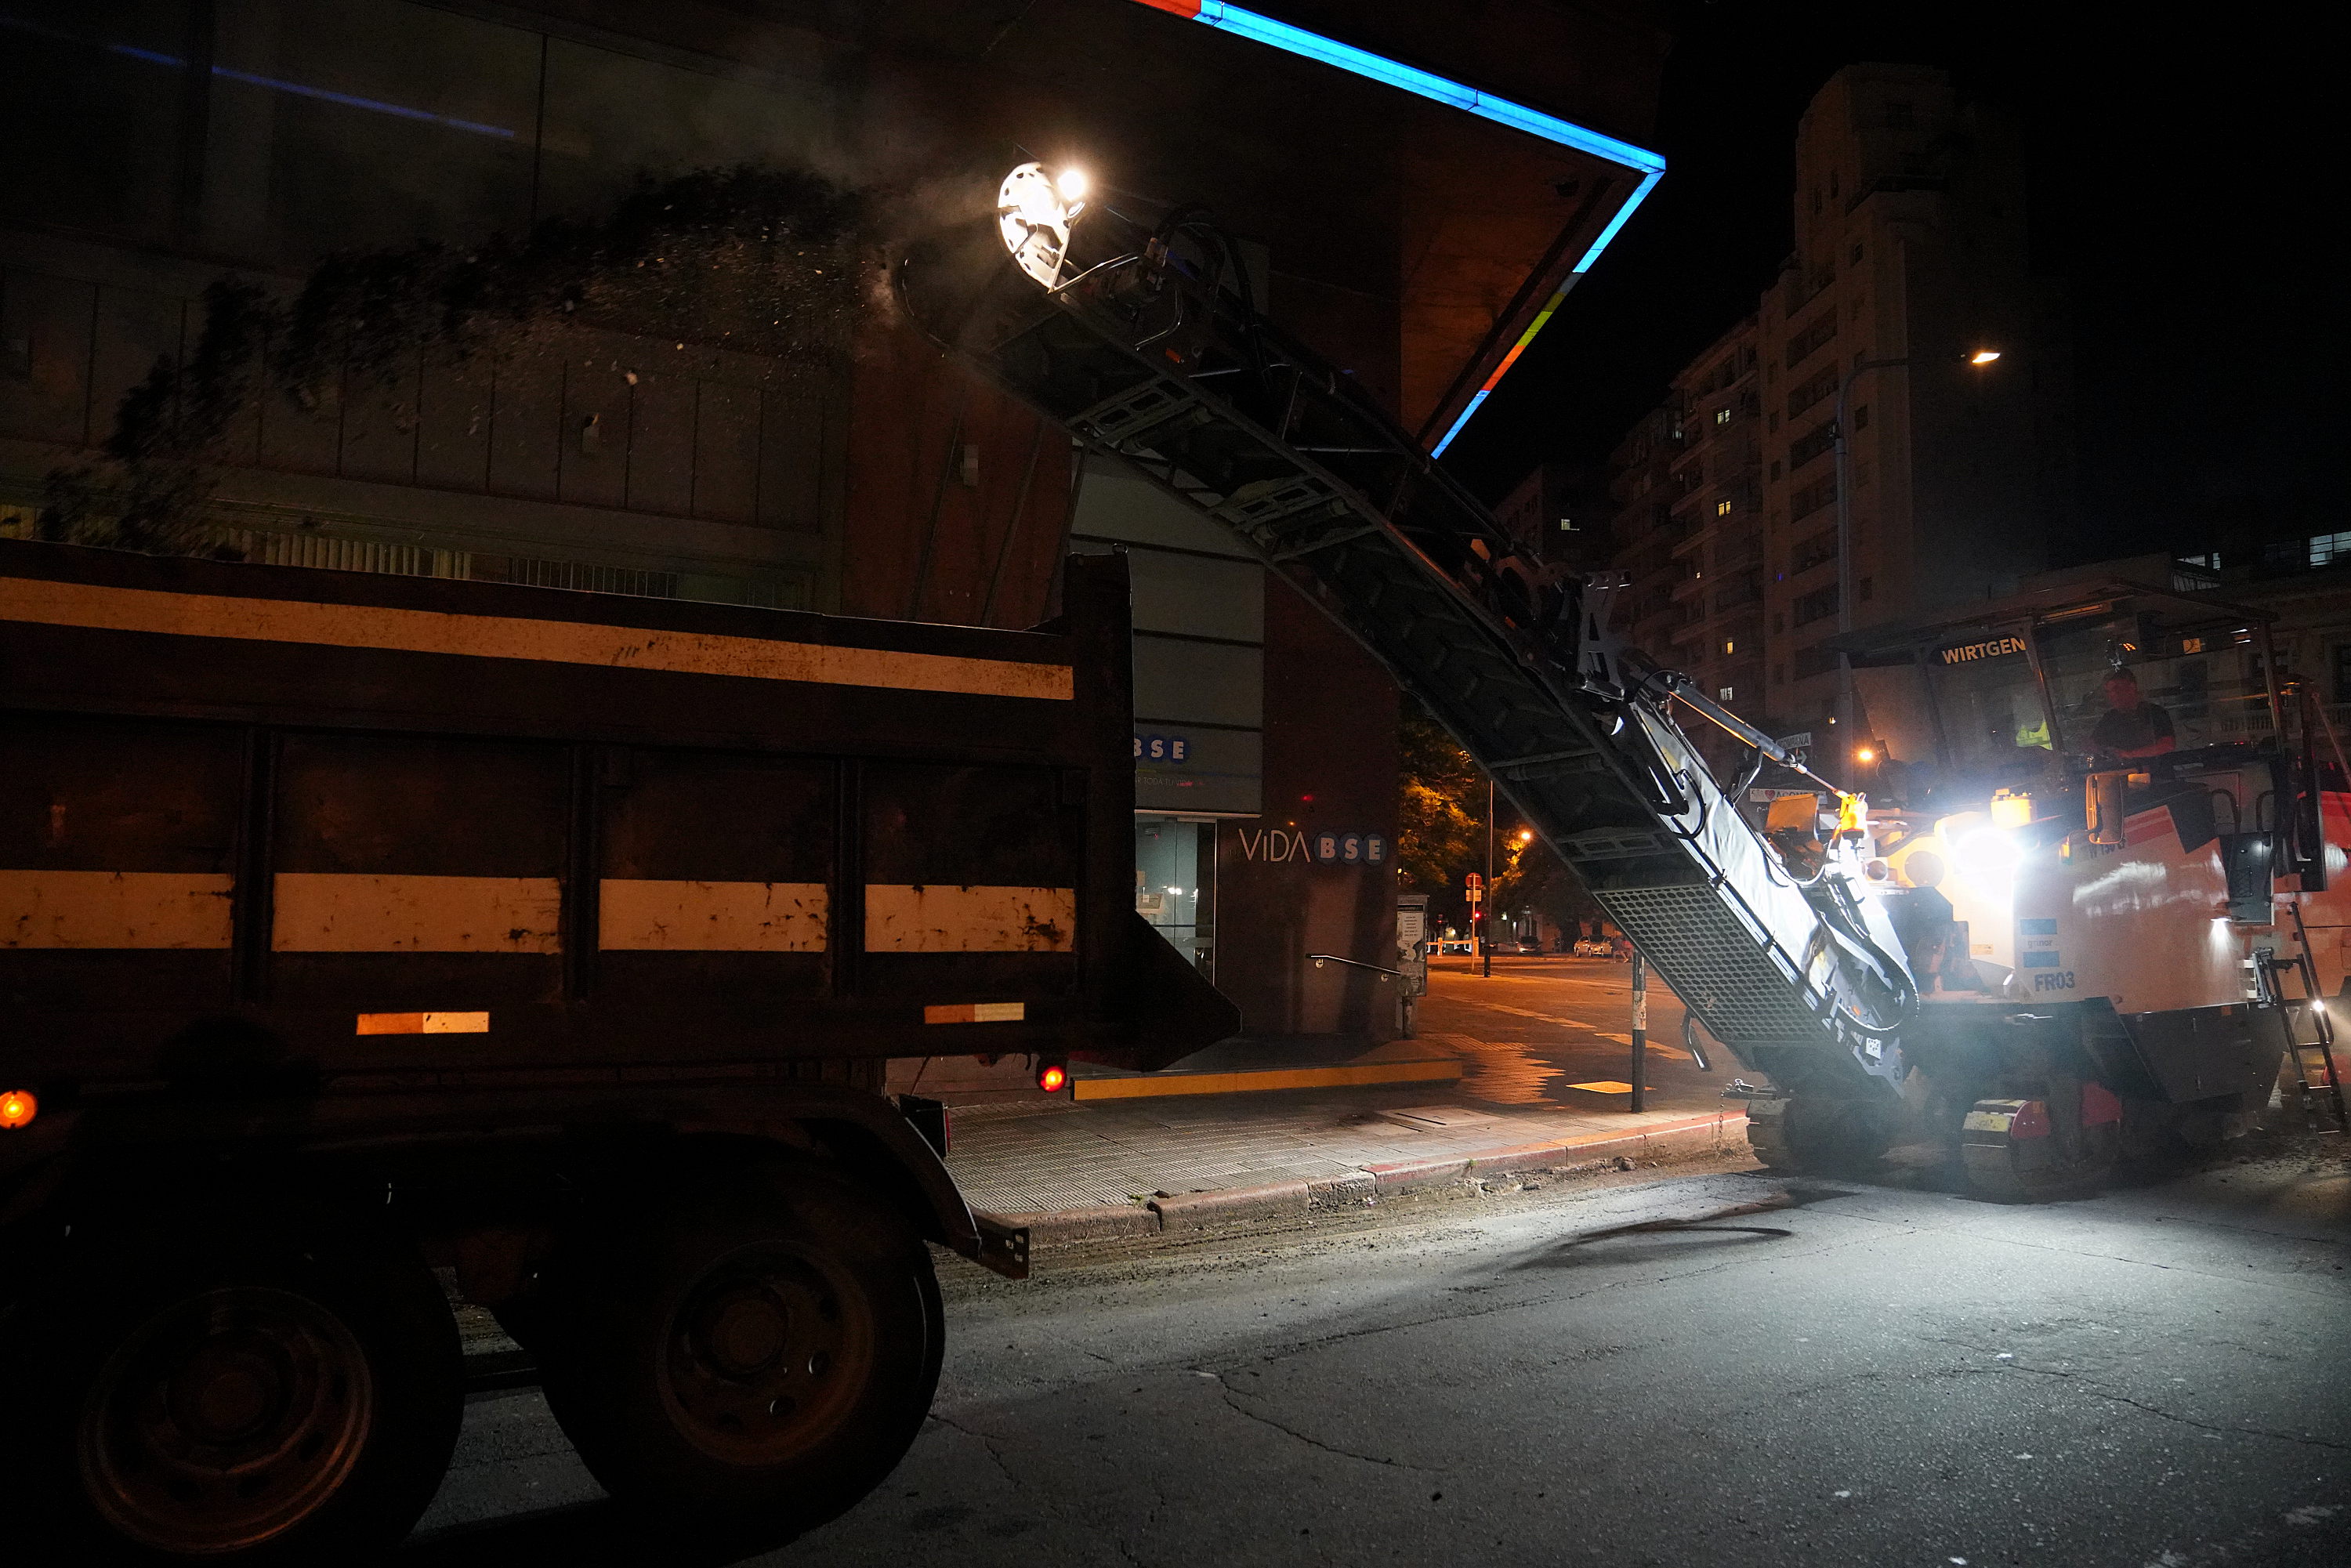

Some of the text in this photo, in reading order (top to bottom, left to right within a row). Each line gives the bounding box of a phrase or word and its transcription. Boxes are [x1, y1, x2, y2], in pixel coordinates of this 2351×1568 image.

[1942, 638, 2027, 664] WIRTGEN
[1238, 827, 1382, 863] VIDA BSE
[2034, 971, 2076, 992] FR03
